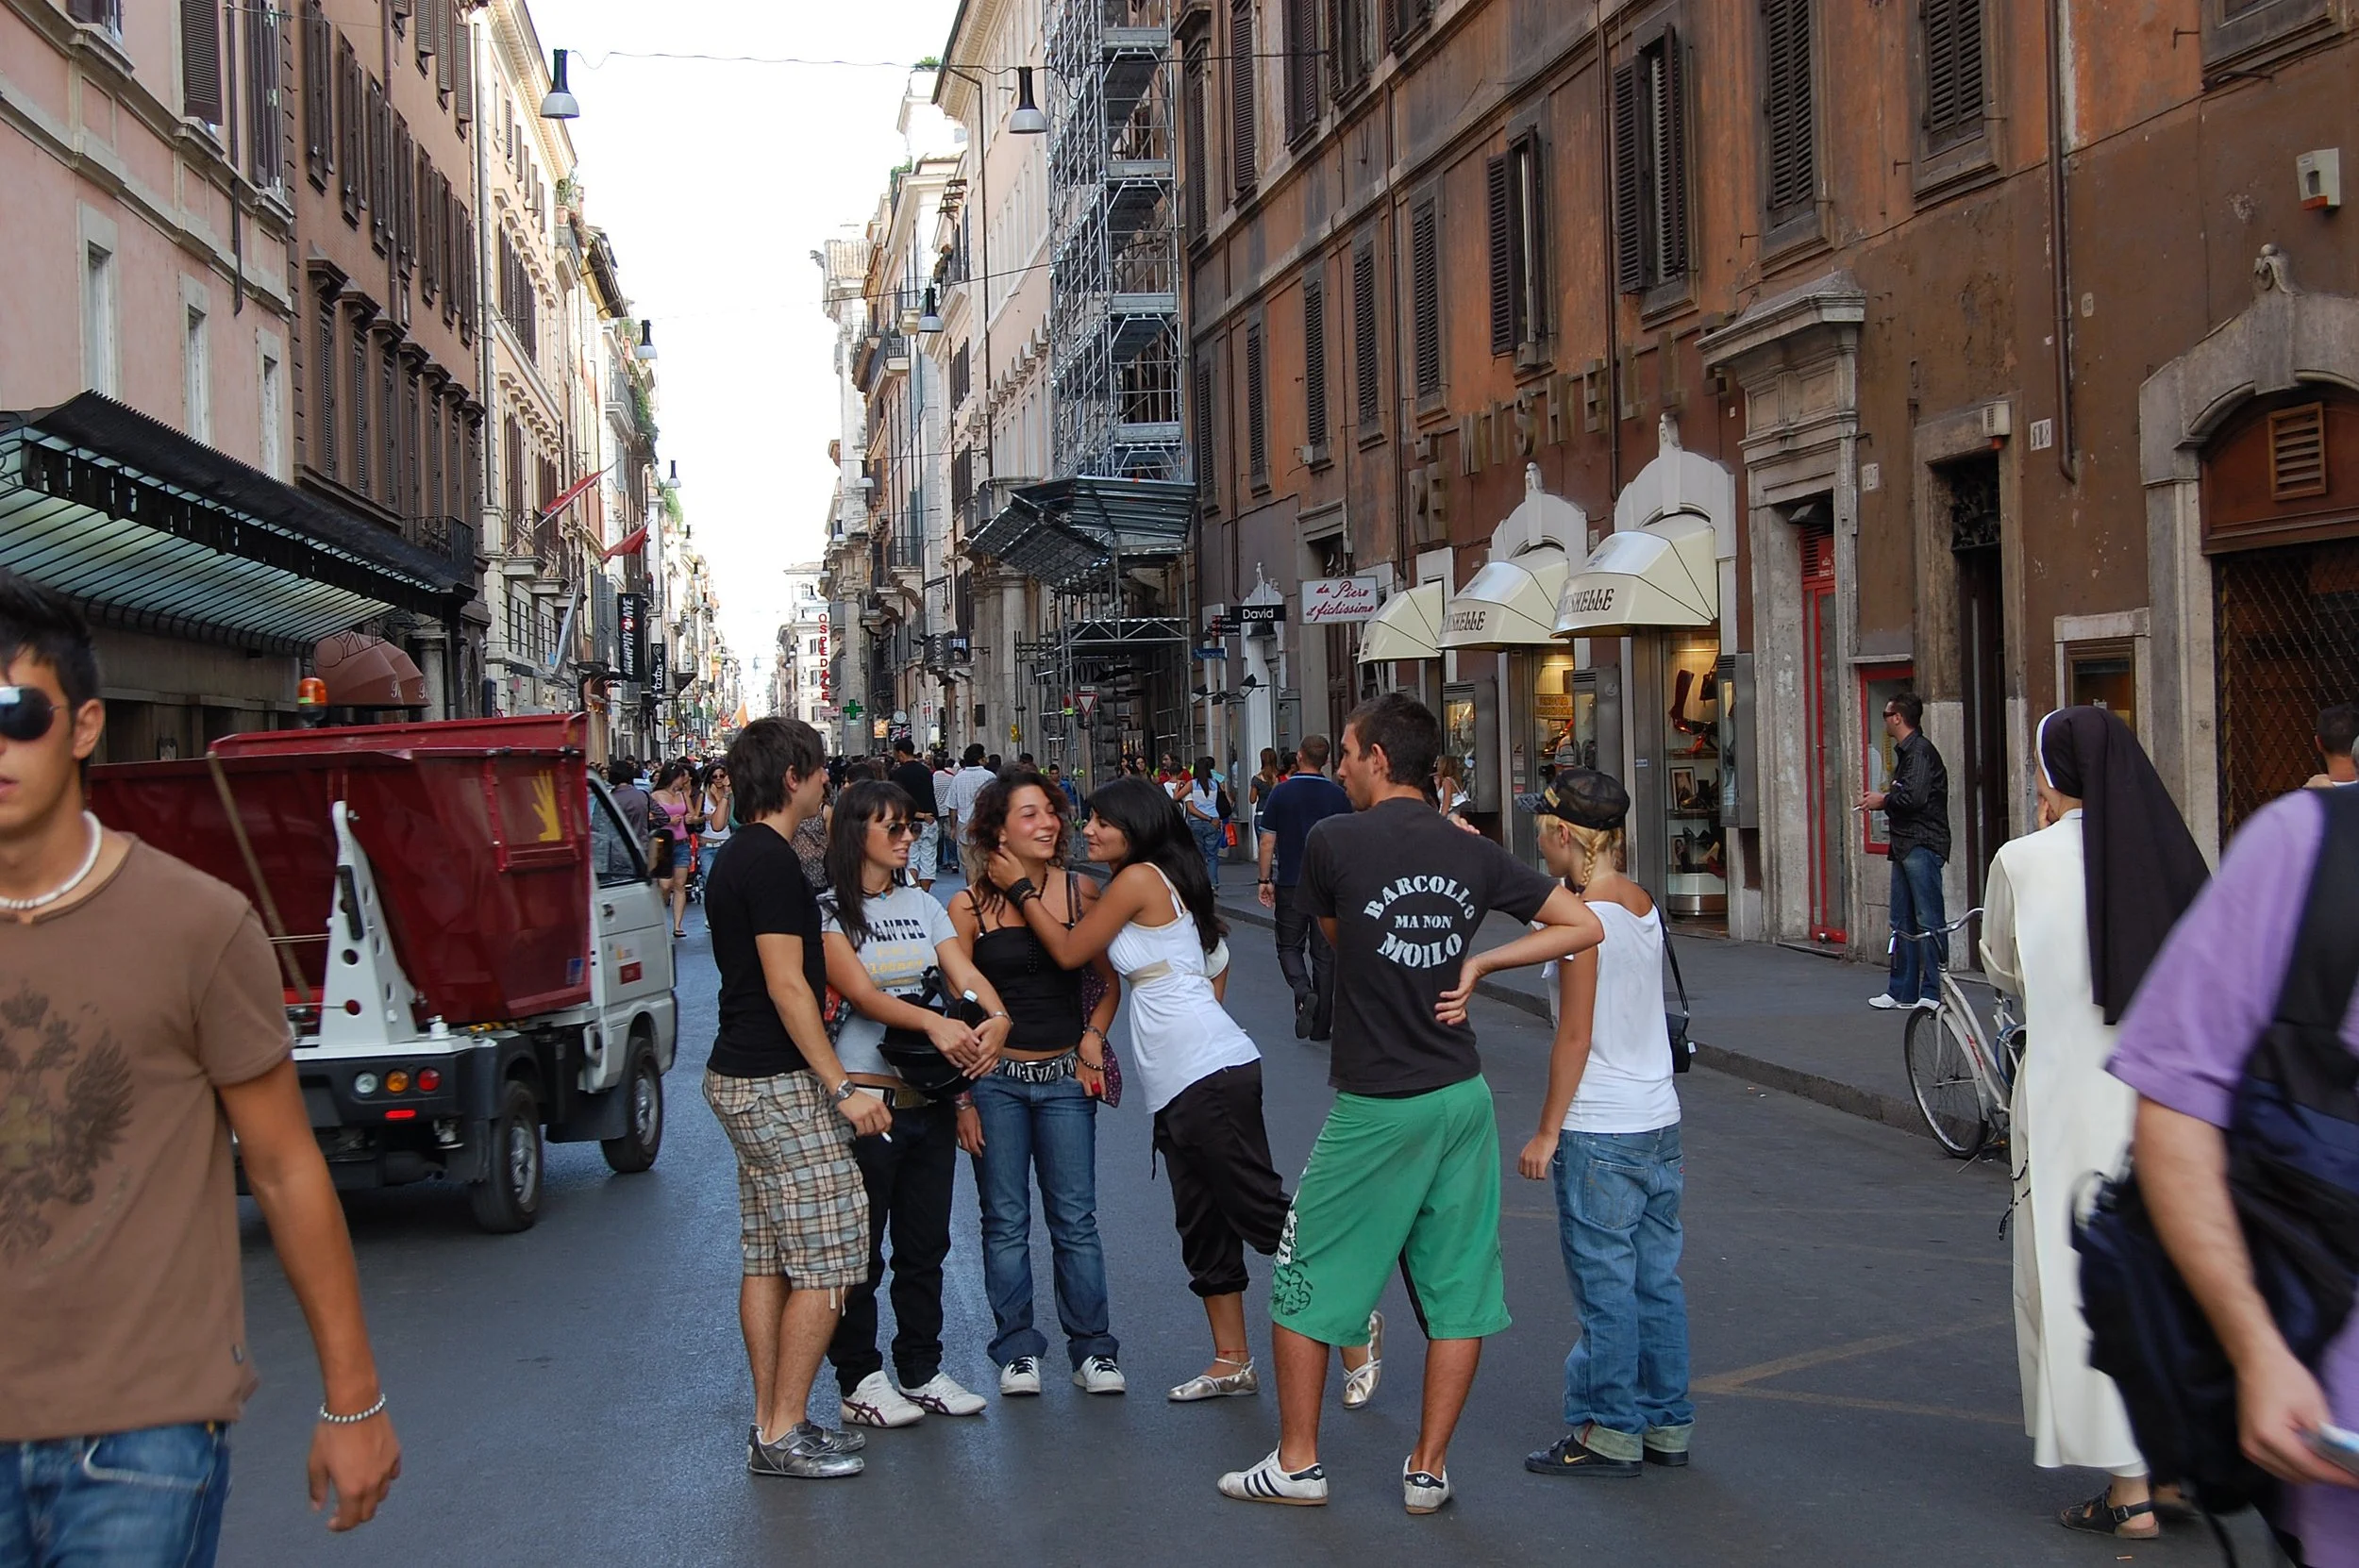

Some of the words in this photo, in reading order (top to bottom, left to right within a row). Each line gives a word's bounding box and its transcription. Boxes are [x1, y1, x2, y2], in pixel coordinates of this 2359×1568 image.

[1331, 580, 1369, 599] Piero
[622, 597, 634, 619] NYE
[1242, 608, 1274, 620] David
[1313, 601, 1375, 622] fichissimo
[622, 629, 634, 676] MURPHY
[818, 613, 831, 701] OSPEDALE
[1364, 875, 1476, 921] BARCOLLO
[1394, 914, 1419, 929] MA
[1422, 914, 1453, 929] NON
